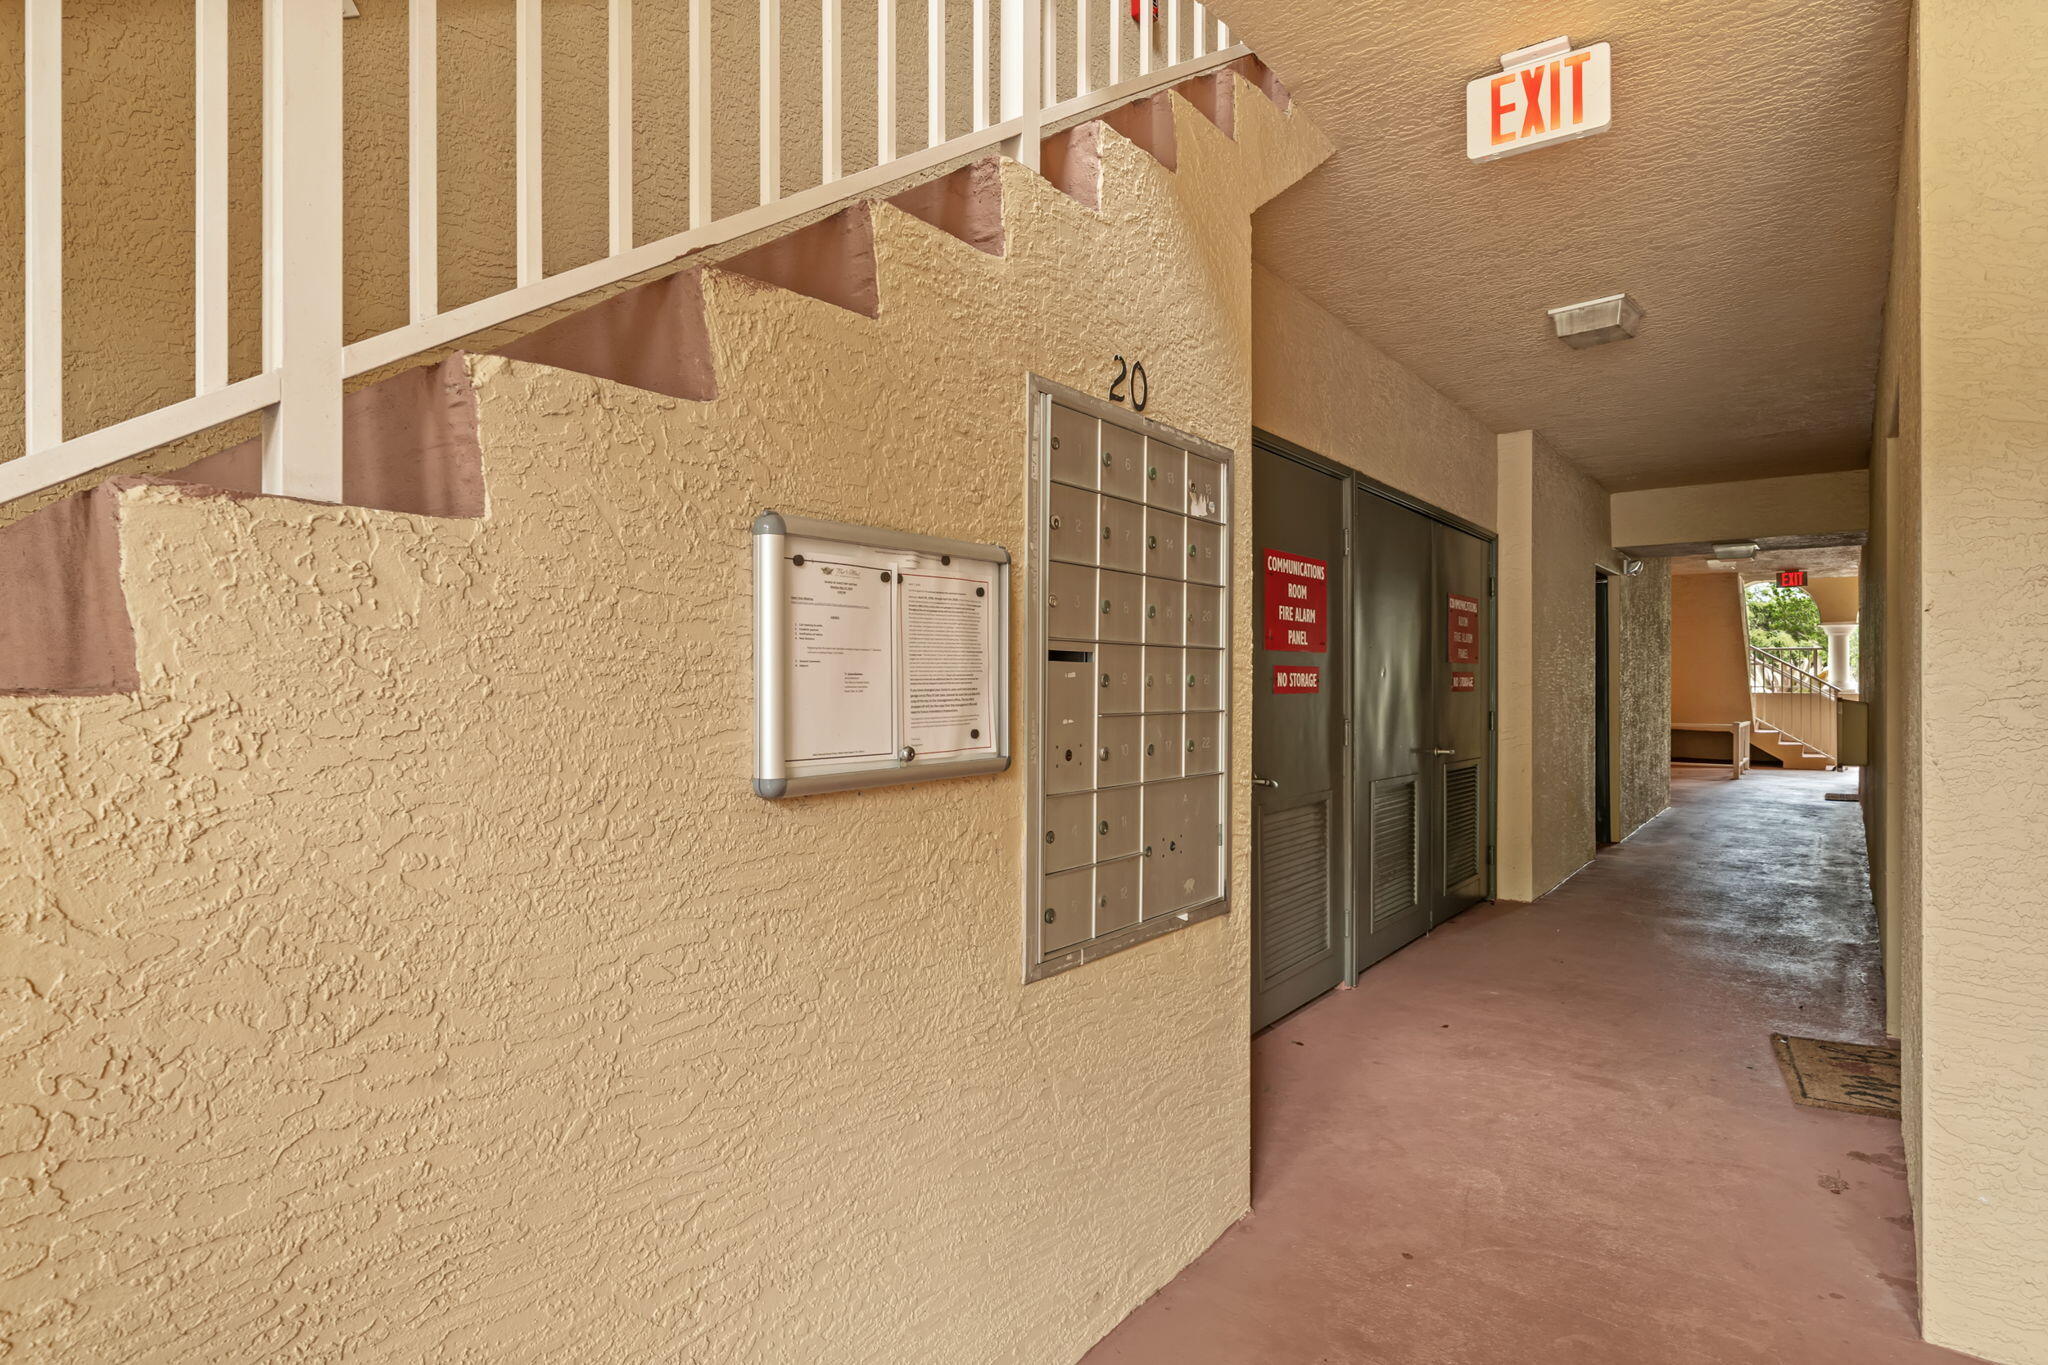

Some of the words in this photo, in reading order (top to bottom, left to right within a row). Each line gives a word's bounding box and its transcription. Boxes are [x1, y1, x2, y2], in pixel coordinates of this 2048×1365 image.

[1491, 52, 1591, 146] EXIT
[1109, 354, 1147, 412] 20
[1125, 457, 1132, 471] 6
[1075, 519, 1081, 533] 2
[1267, 556, 1325, 580] COMMUNICATIONS
[1781, 571, 1803, 586] EXIT
[1288, 583, 1308, 600] ROOM
[1279, 605, 1294, 621] FIRE
[1295, 607, 1316, 623] ALARM
[1288, 630, 1308, 645] PANEL
[1277, 672, 1288, 687] NO
[1289, 672, 1317, 687] STORAGE
